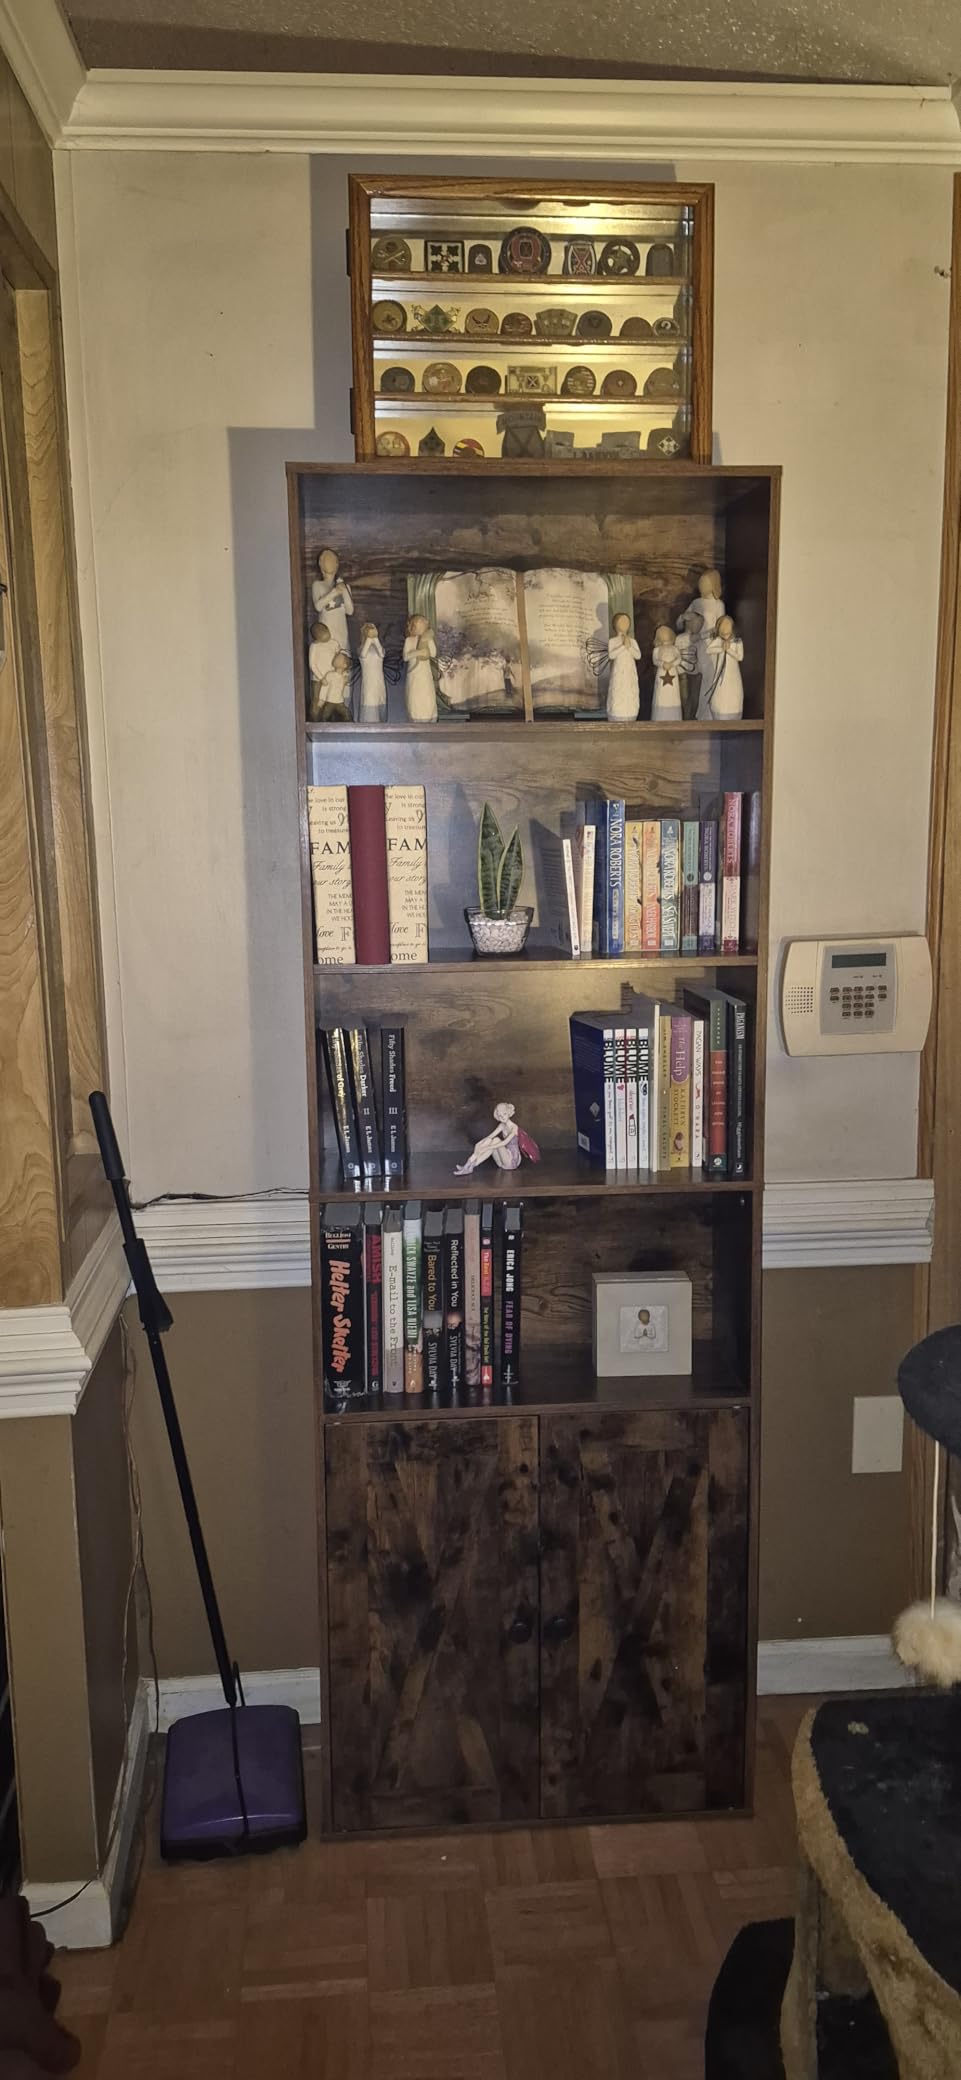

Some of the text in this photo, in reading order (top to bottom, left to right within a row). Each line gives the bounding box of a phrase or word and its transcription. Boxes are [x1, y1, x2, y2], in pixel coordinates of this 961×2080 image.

[610, 818, 622, 844] NORA
[312, 860, 344, 876] Family
[390, 857, 422, 871] Family
[610, 848, 622, 888] ROBERTS
[735, 1012, 745, 1040] PAGANISM
[604, 1040, 614, 1083] BLUME
[615, 1040, 625, 1083] BLUME
[627, 1040, 636, 1082] BLUME
[638, 1039, 648, 1082] BLUME
[674, 1051, 685, 1076] Help
[371, 1234, 382, 1284] AMISH
[406, 1257, 417, 1282] SWAYZE
[451, 1239, 459, 1308] Reflected in You
[506, 1250, 514, 1292] ERICA JONG
[407, 1286, 416, 1297] and
[427, 1255, 436, 1311] Bared to You
[328, 1260, 352, 1373] Helter Skelter
[388, 1265, 398, 1368] E-mail to the Front
[407, 1300, 416, 1317] LISA
[407, 1318, 417, 1338] NIEMI
[504, 1301, 513, 1354] FEAR OF DYING
[428, 1342, 438, 1378] SYLVIA DAY
[449, 1335, 458, 1358] SYLVIA
